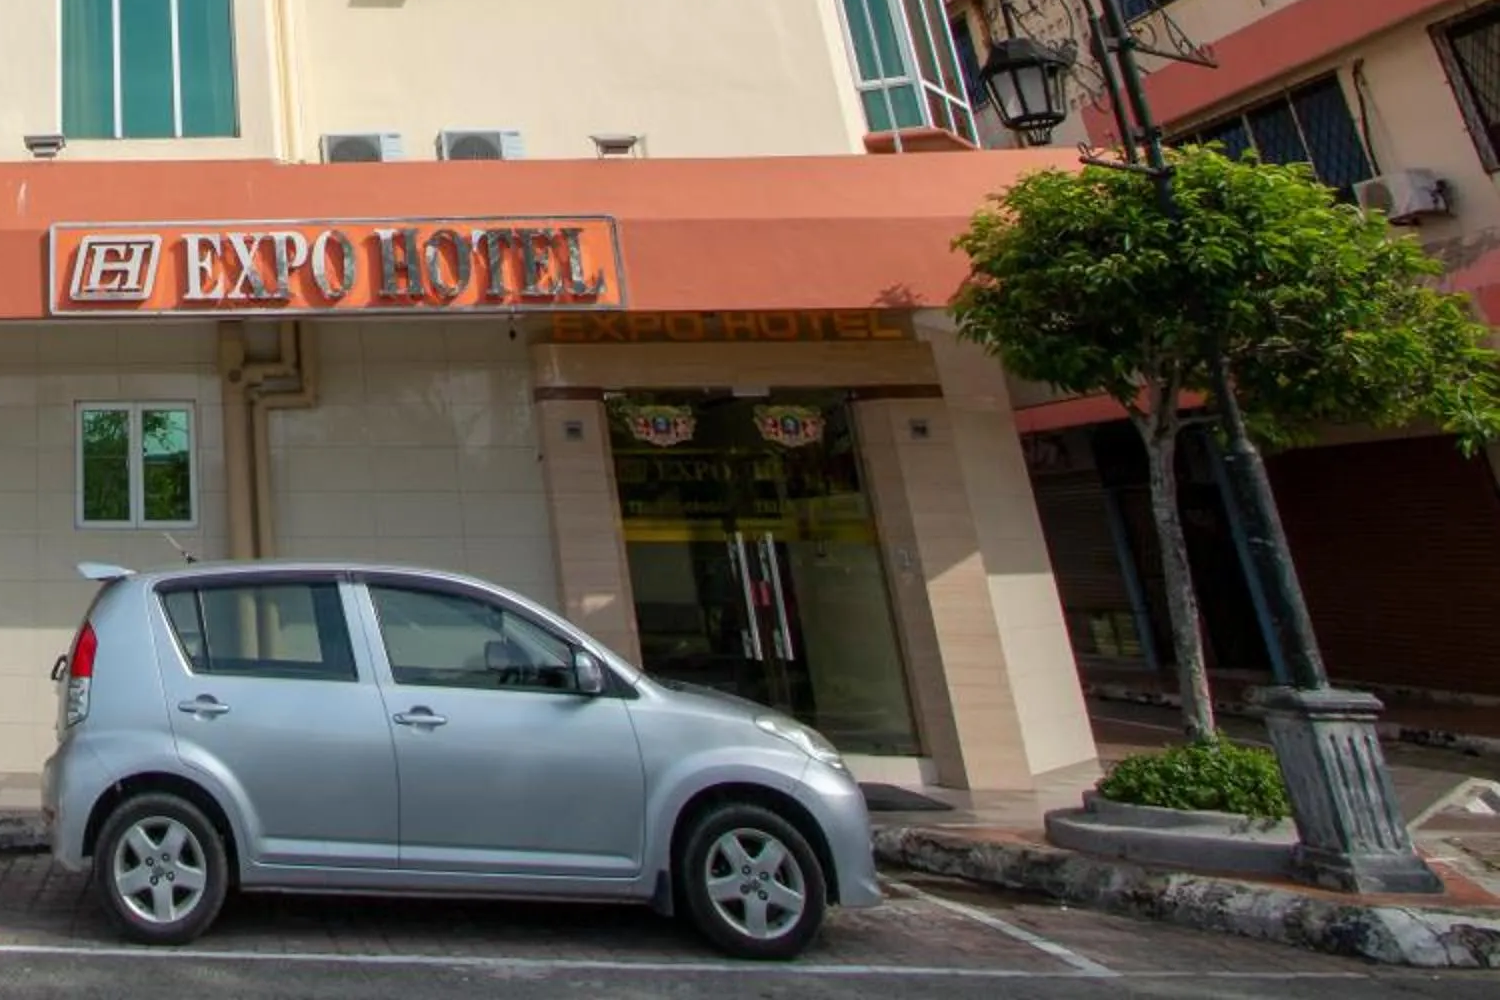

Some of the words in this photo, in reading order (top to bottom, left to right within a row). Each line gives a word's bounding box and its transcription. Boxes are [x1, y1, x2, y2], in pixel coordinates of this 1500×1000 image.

[181, 229, 356, 299] EXPO
[373, 227, 606, 299] HOTEL
[551, 310, 704, 341] EXPO
[721, 309, 903, 340] HOTEL
